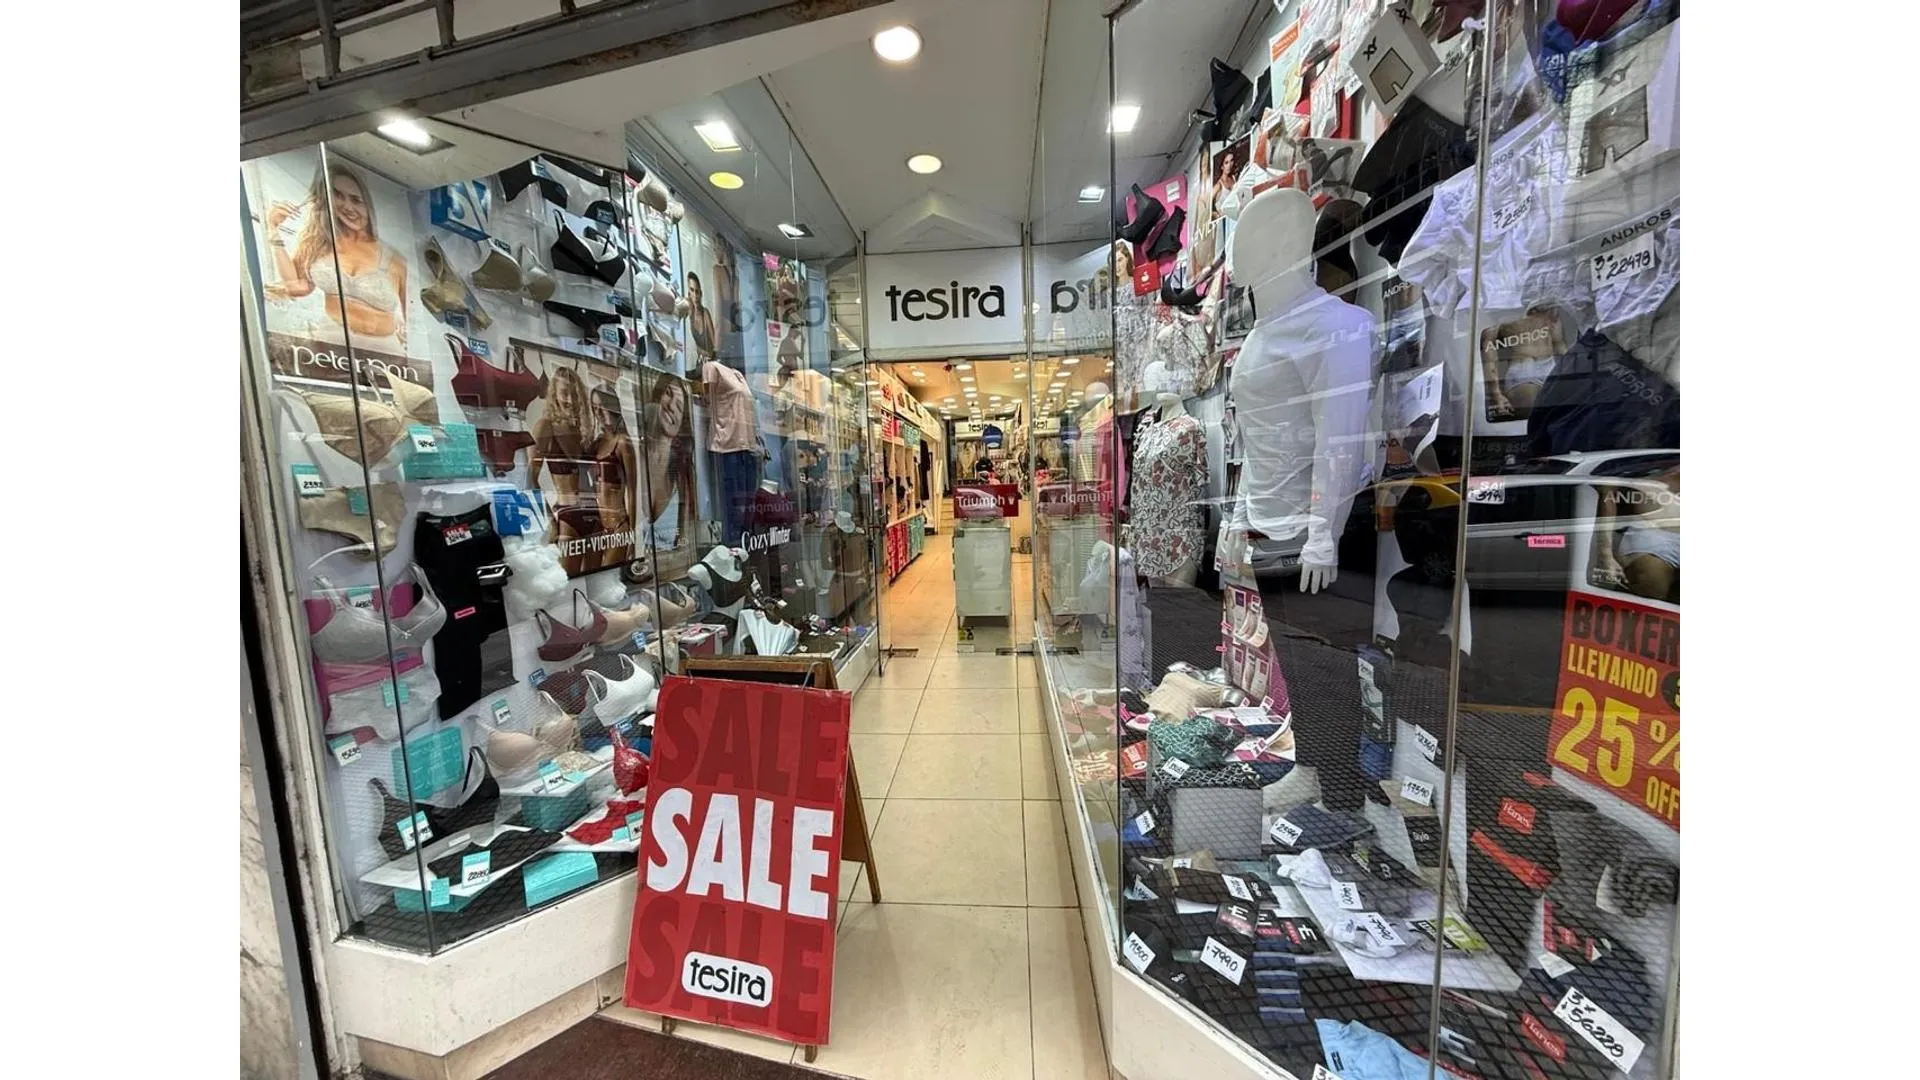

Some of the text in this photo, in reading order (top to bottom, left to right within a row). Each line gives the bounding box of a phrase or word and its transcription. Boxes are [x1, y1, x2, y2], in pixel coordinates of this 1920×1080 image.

[1600, 208, 1672, 247] ANDROS
[885, 281, 1005, 322] tesira
[1485, 326, 1549, 352] ANDROS
[956, 495, 1004, 508] Triumph
[1567, 643, 1658, 698] LLEVANDO
[657, 682, 841, 802] SALE
[1645, 775, 1680, 820] OFF
[647, 787, 834, 920] SALE
[689, 957, 766, 1002] tesira
